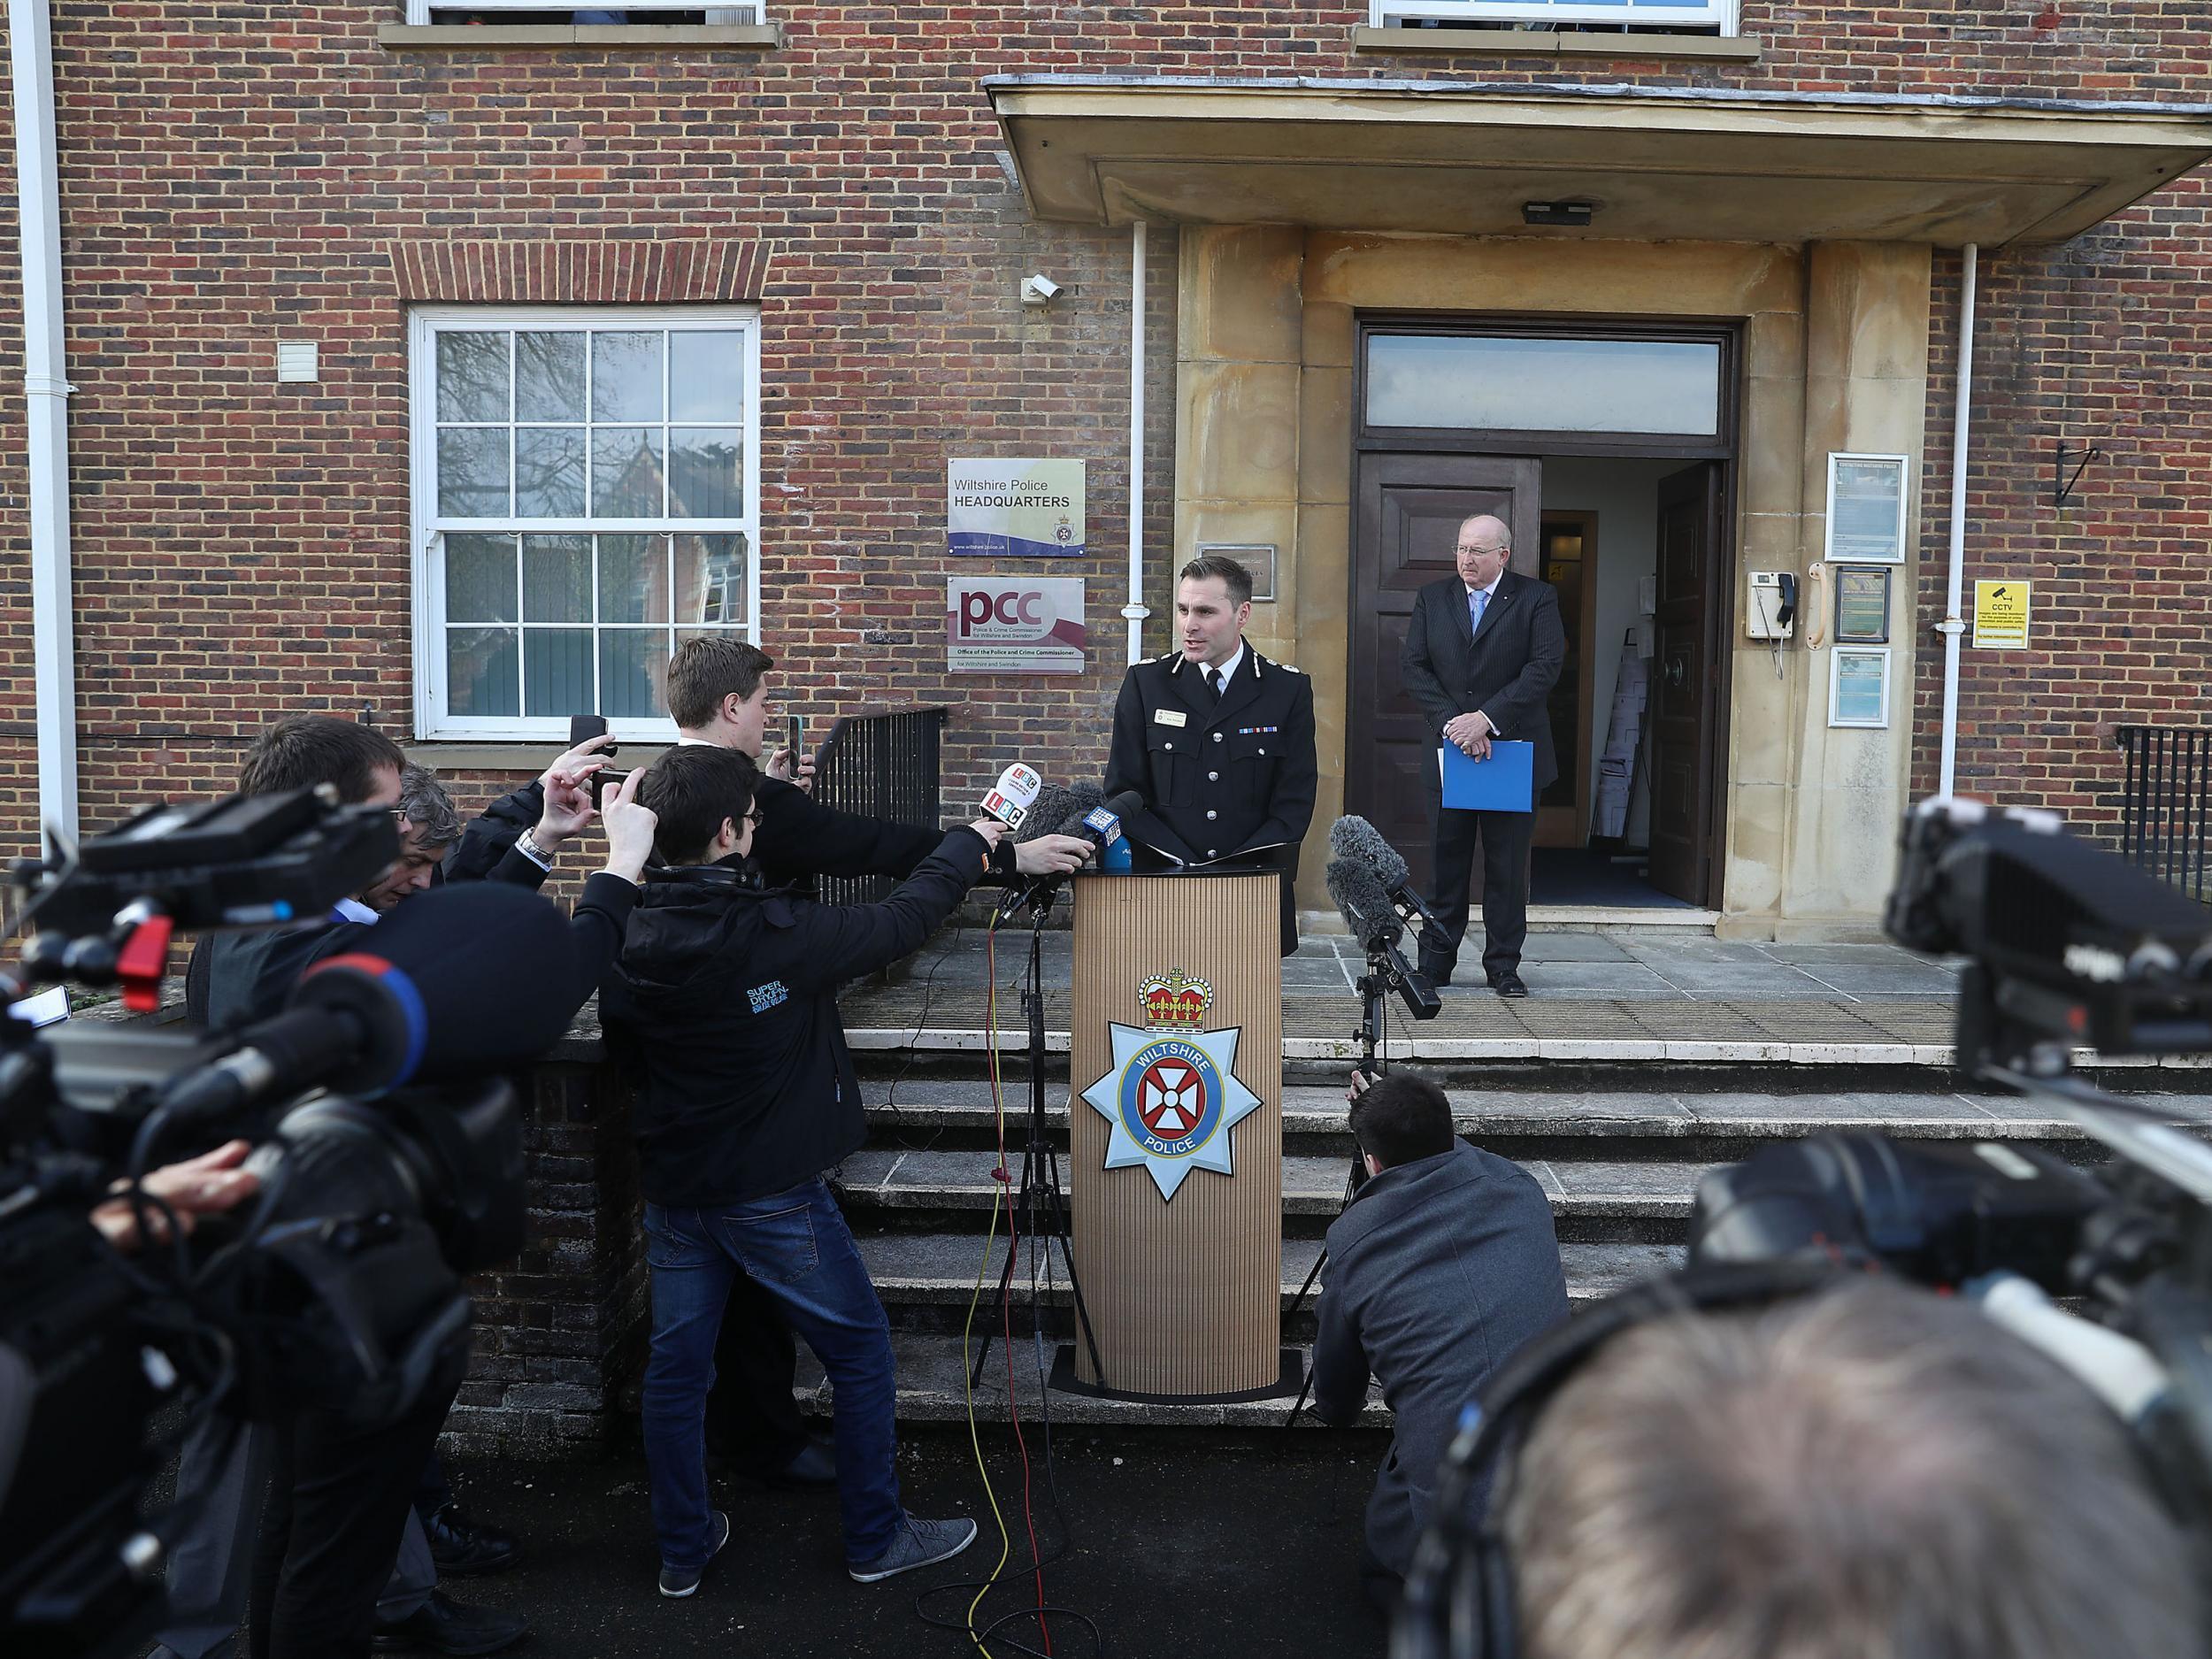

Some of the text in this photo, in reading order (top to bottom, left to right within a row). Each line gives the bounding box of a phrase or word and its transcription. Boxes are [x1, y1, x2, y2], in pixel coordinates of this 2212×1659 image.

[954, 479, 1048, 491] Wiltshire Police
[955, 495, 1070, 508] HEADQUARTERS
[960, 591, 1042, 637] pcc
[1013, 768, 1037, 788] LBC
[987, 793, 1023, 824] LBC
[747, 980, 781, 997] SUPER
[1135, 1042, 1211, 1073] WILTSHIRE
[1143, 1135, 1196, 1155] POLICE
